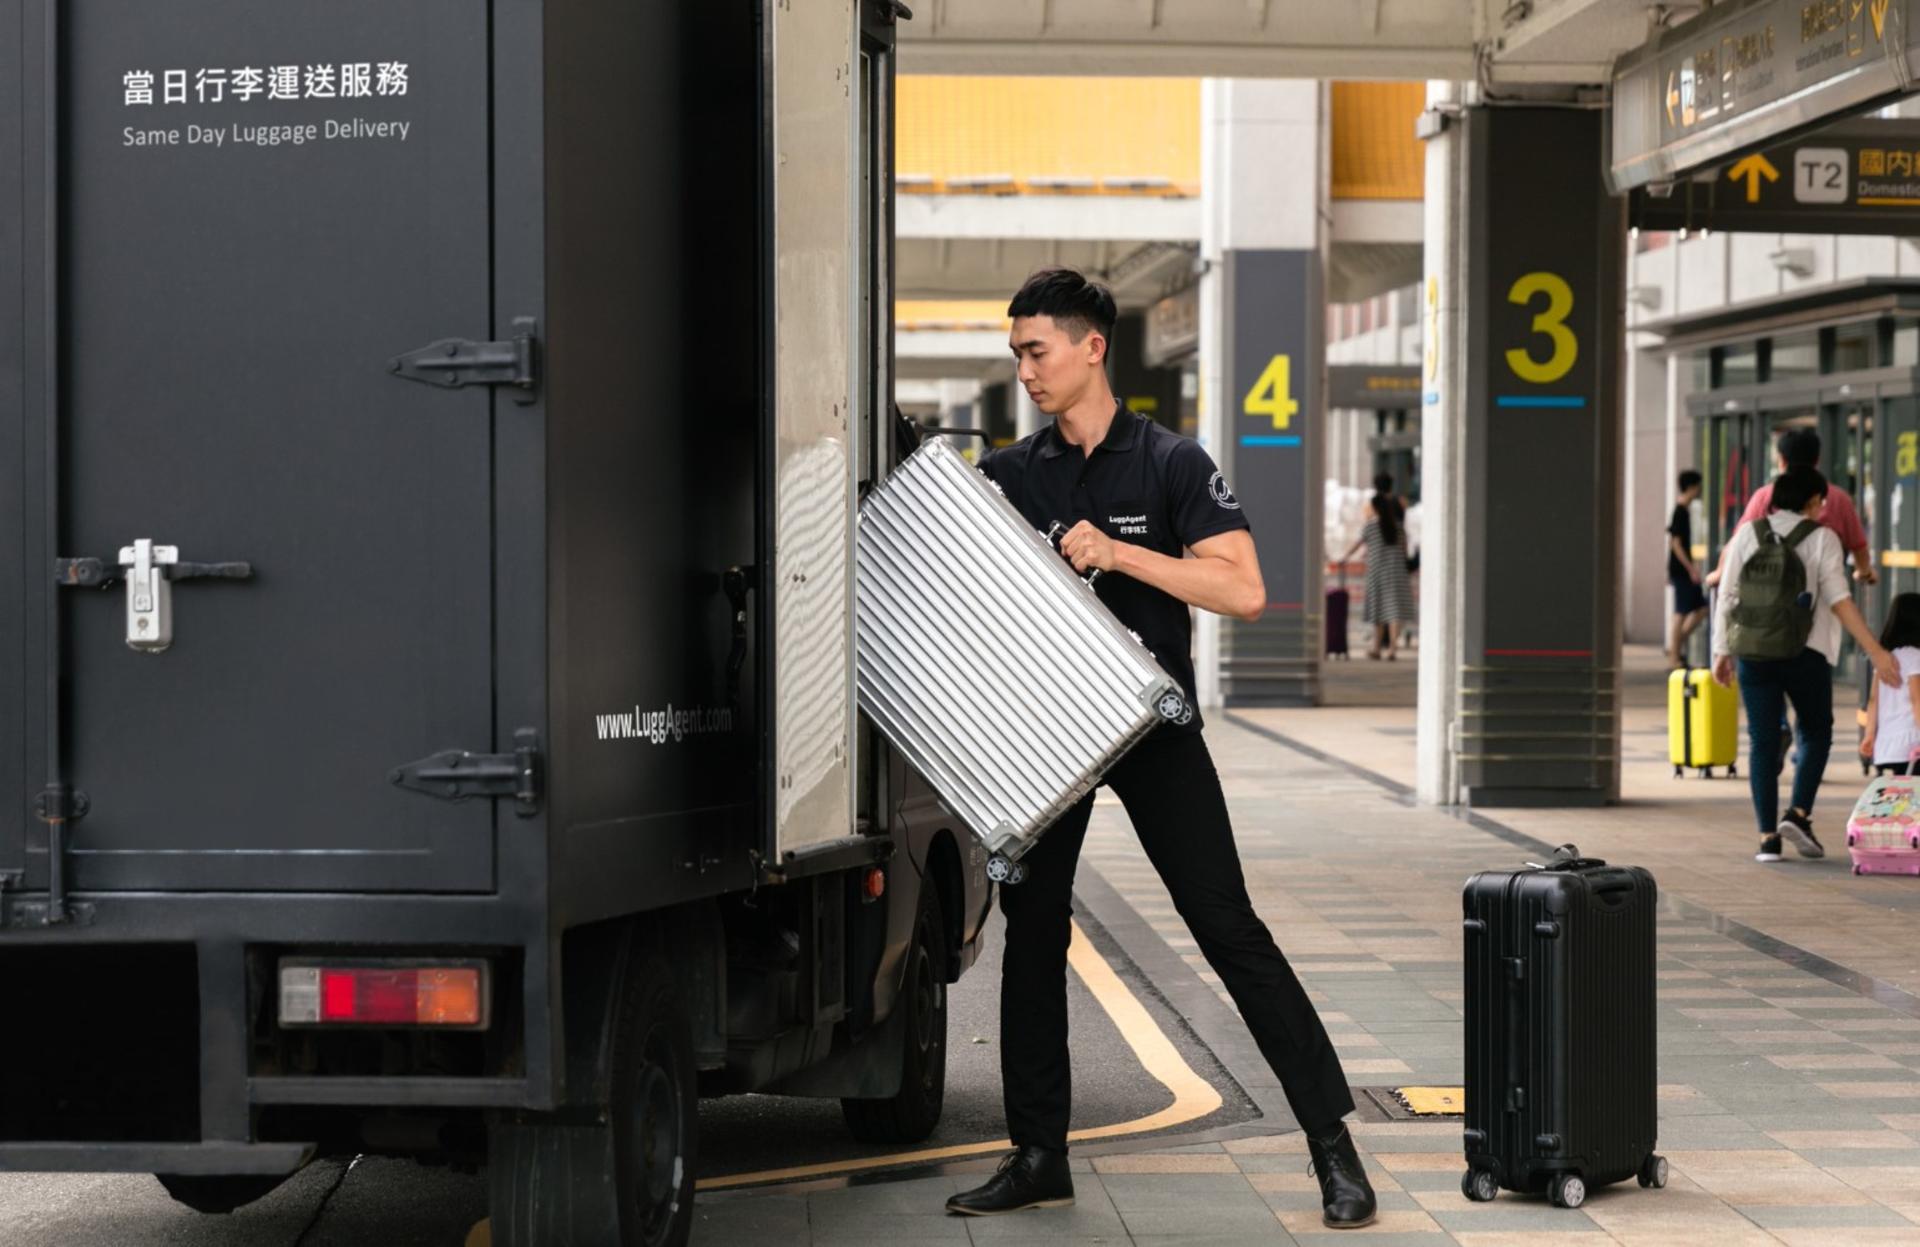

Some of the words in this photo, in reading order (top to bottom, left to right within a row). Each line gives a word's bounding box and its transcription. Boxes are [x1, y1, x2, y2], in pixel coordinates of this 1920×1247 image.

[123, 61, 409, 105] 當日行李運送服務
[123, 127, 179, 146] Same
[187, 124, 226, 147] Day
[233, 122, 317, 145] Luggage
[325, 118, 410, 140] Delivery
[1801, 161, 1842, 189] T2
[1859, 148, 1920, 177] 國內
[1505, 271, 1578, 384] 3
[1244, 354, 1298, 429] 4
[1109, 514, 1147, 524] LuggAgent
[596, 703, 732, 744] www.LuggAgent.com
